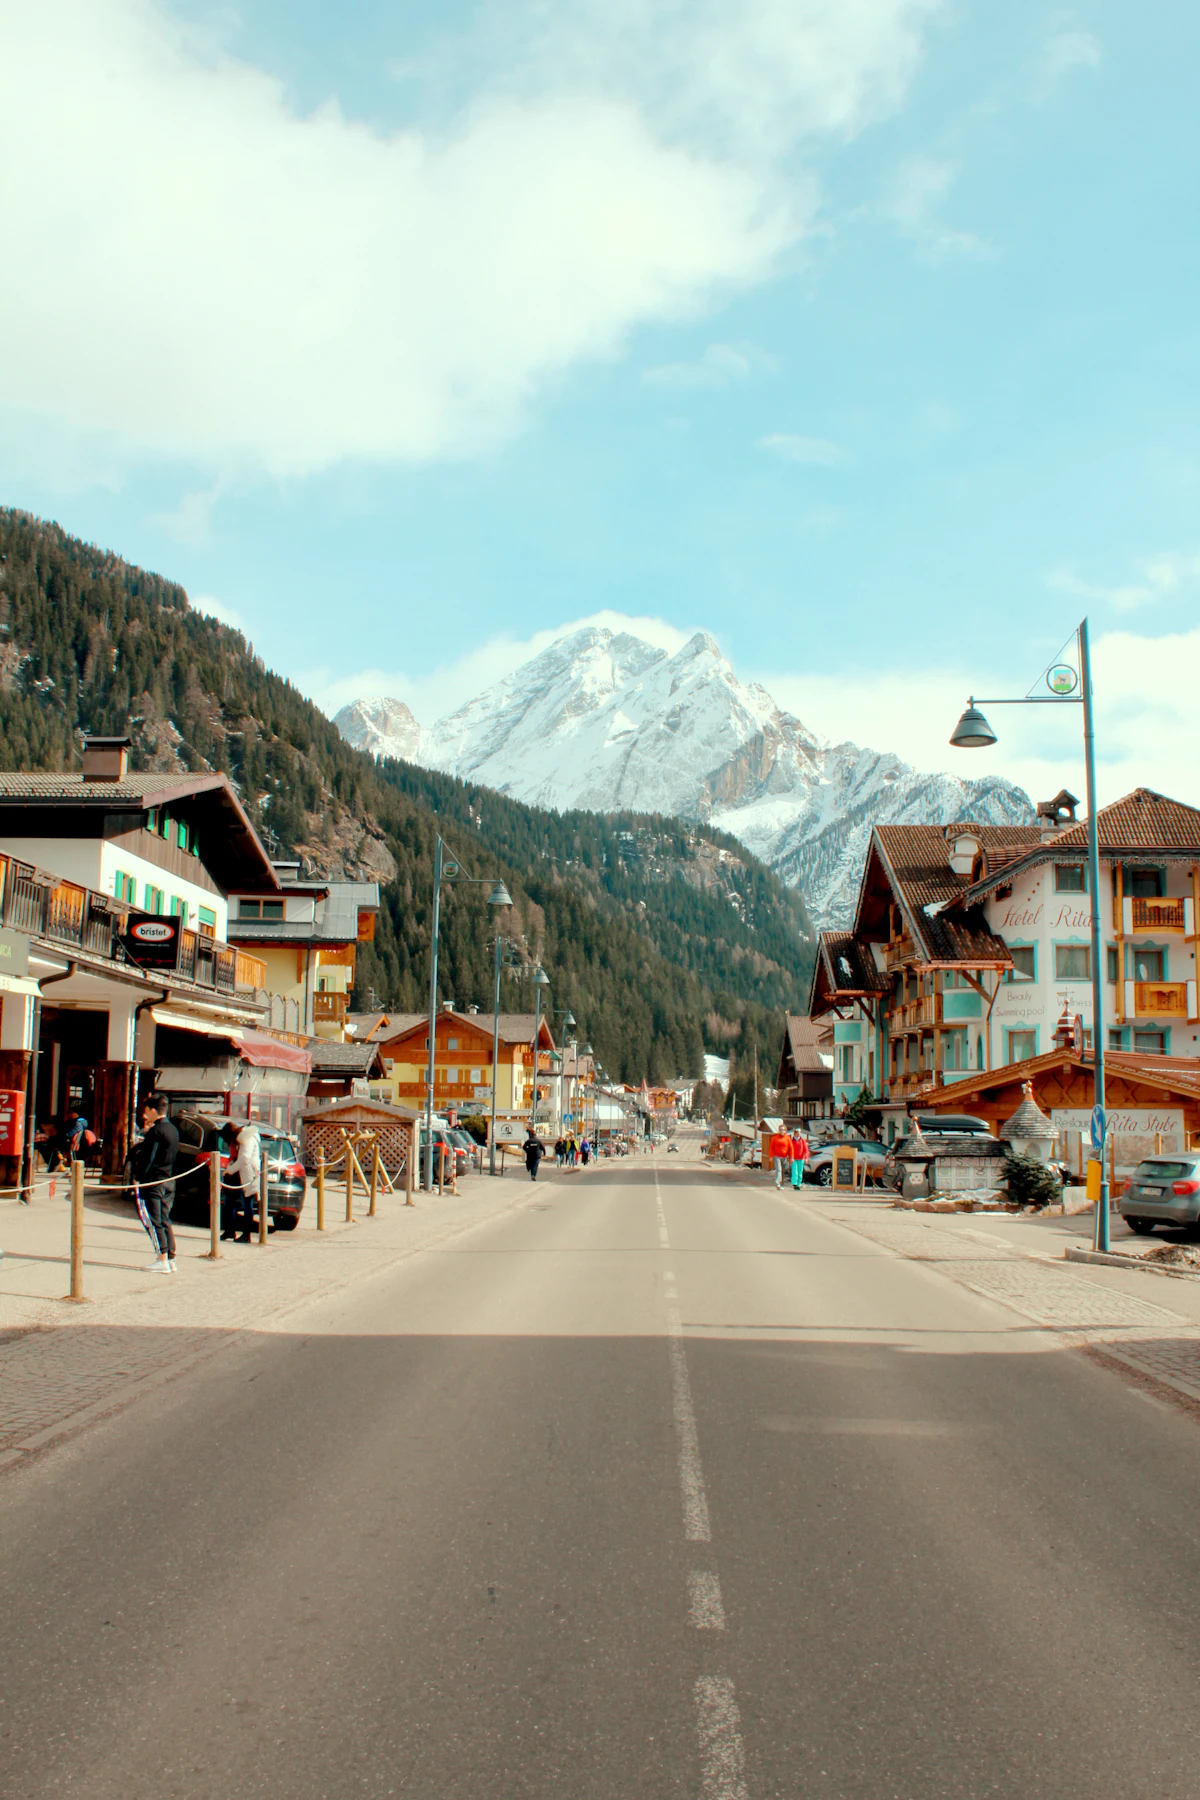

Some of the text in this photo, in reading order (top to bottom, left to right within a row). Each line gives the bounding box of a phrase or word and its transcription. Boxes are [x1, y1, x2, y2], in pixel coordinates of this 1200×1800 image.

[997, 904, 1092, 929] Hotel Rita
[140, 927, 167, 936] bristot
[1056, 996, 1092, 1007] Wllness
[1026, 1005, 1045, 1018] pool
[1054, 1112, 1178, 1132] Restaur Rita Stube
